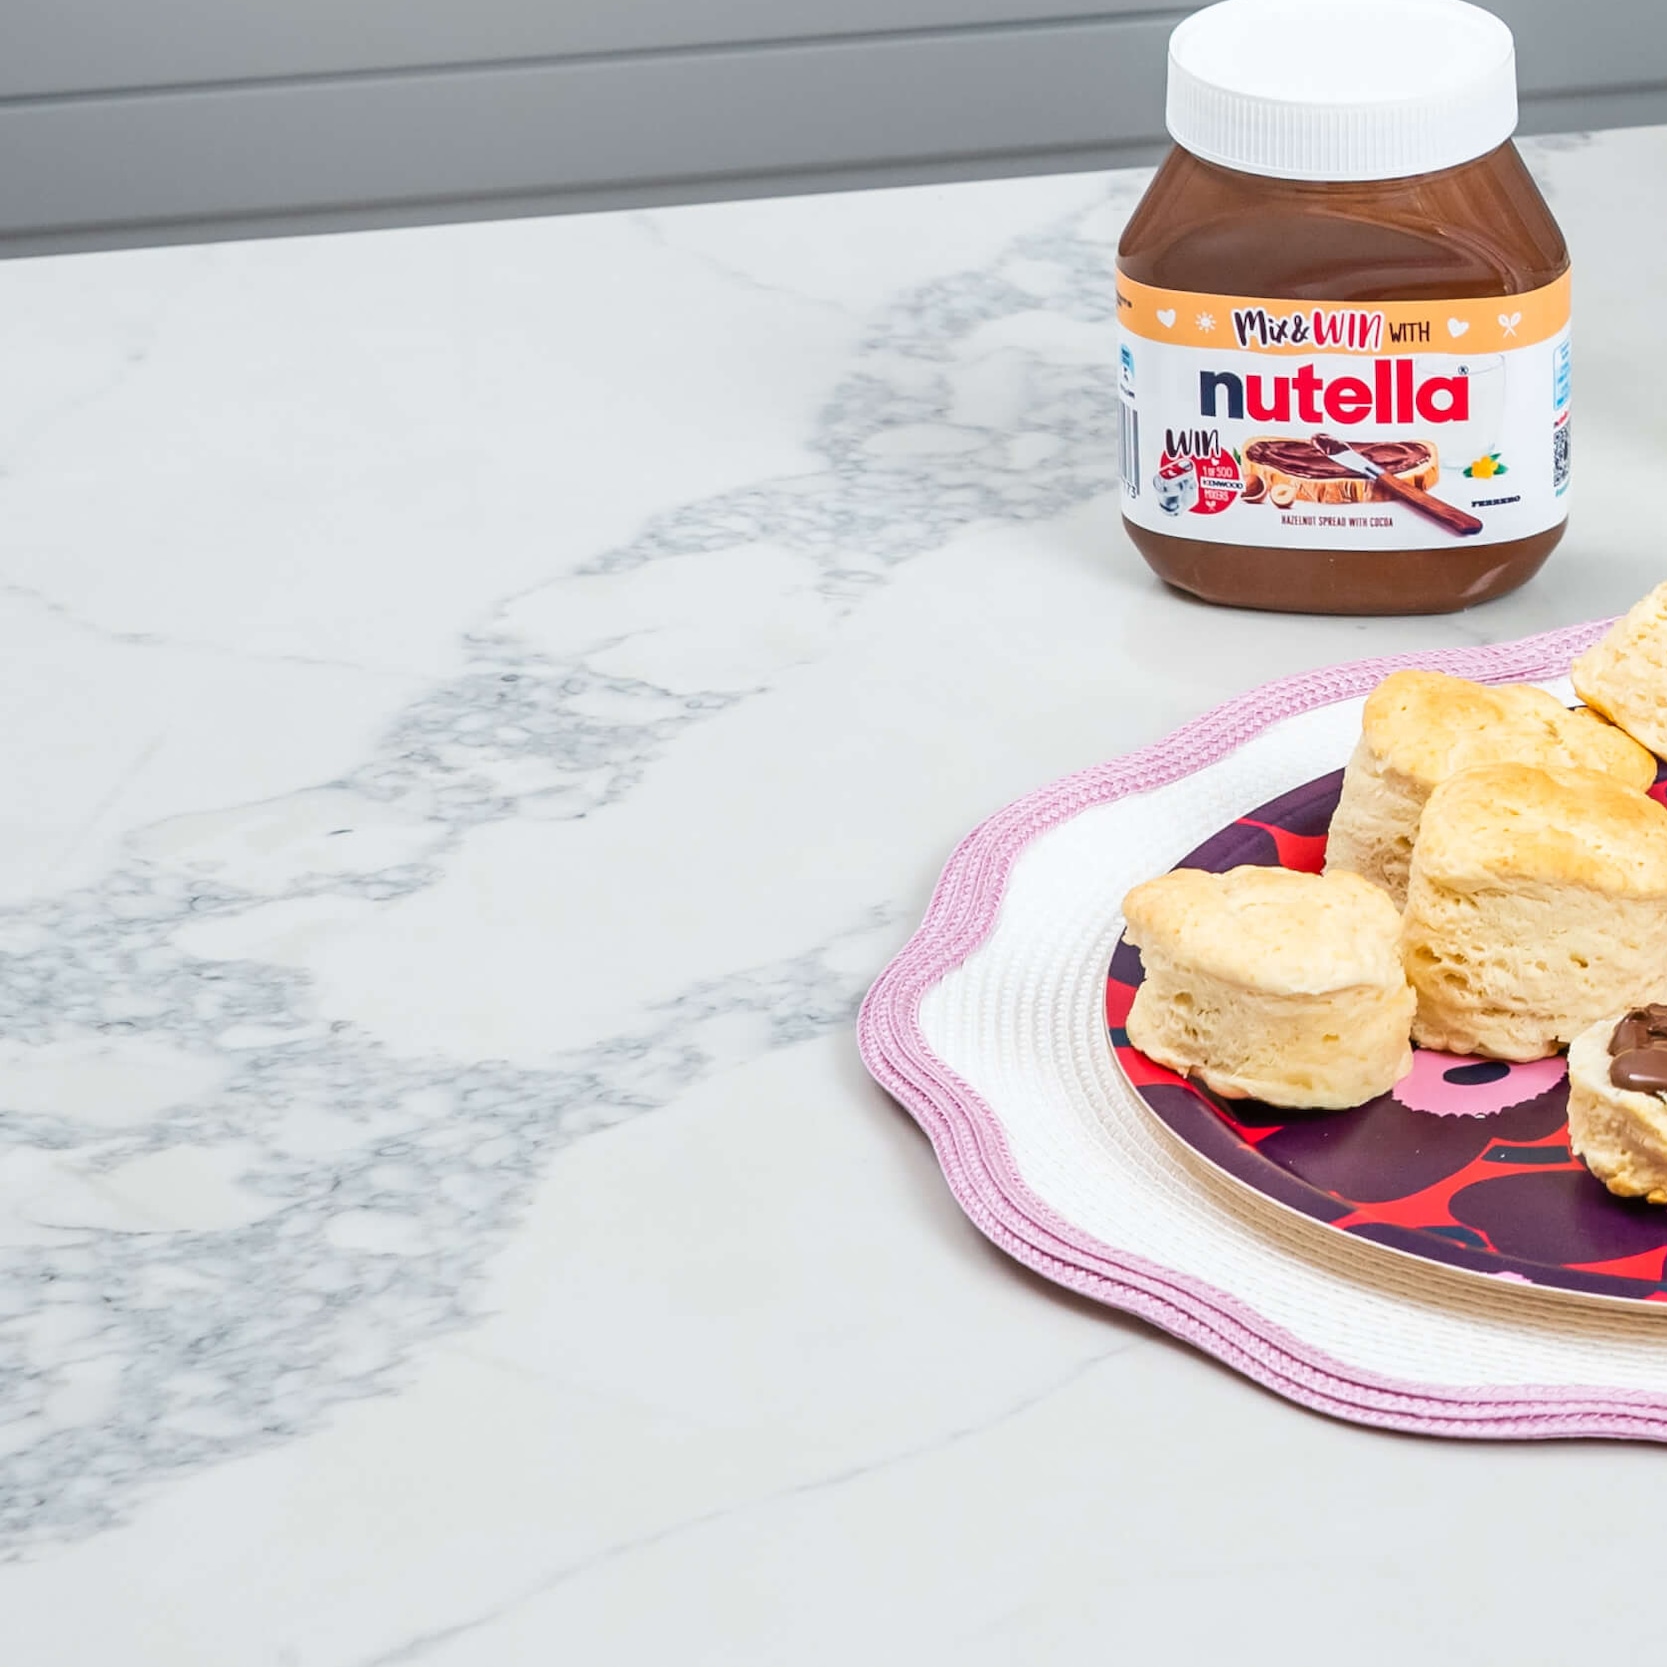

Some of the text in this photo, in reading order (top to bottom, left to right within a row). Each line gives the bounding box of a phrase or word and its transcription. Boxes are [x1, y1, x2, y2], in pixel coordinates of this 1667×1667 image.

[1389, 321, 1430, 343] WITH
[1199, 358, 1470, 425] nutella
[1202, 478, 1244, 490] KENWOOD
[1281, 515, 1394, 528] HAZELNUT SPREAD WITH COCOA
